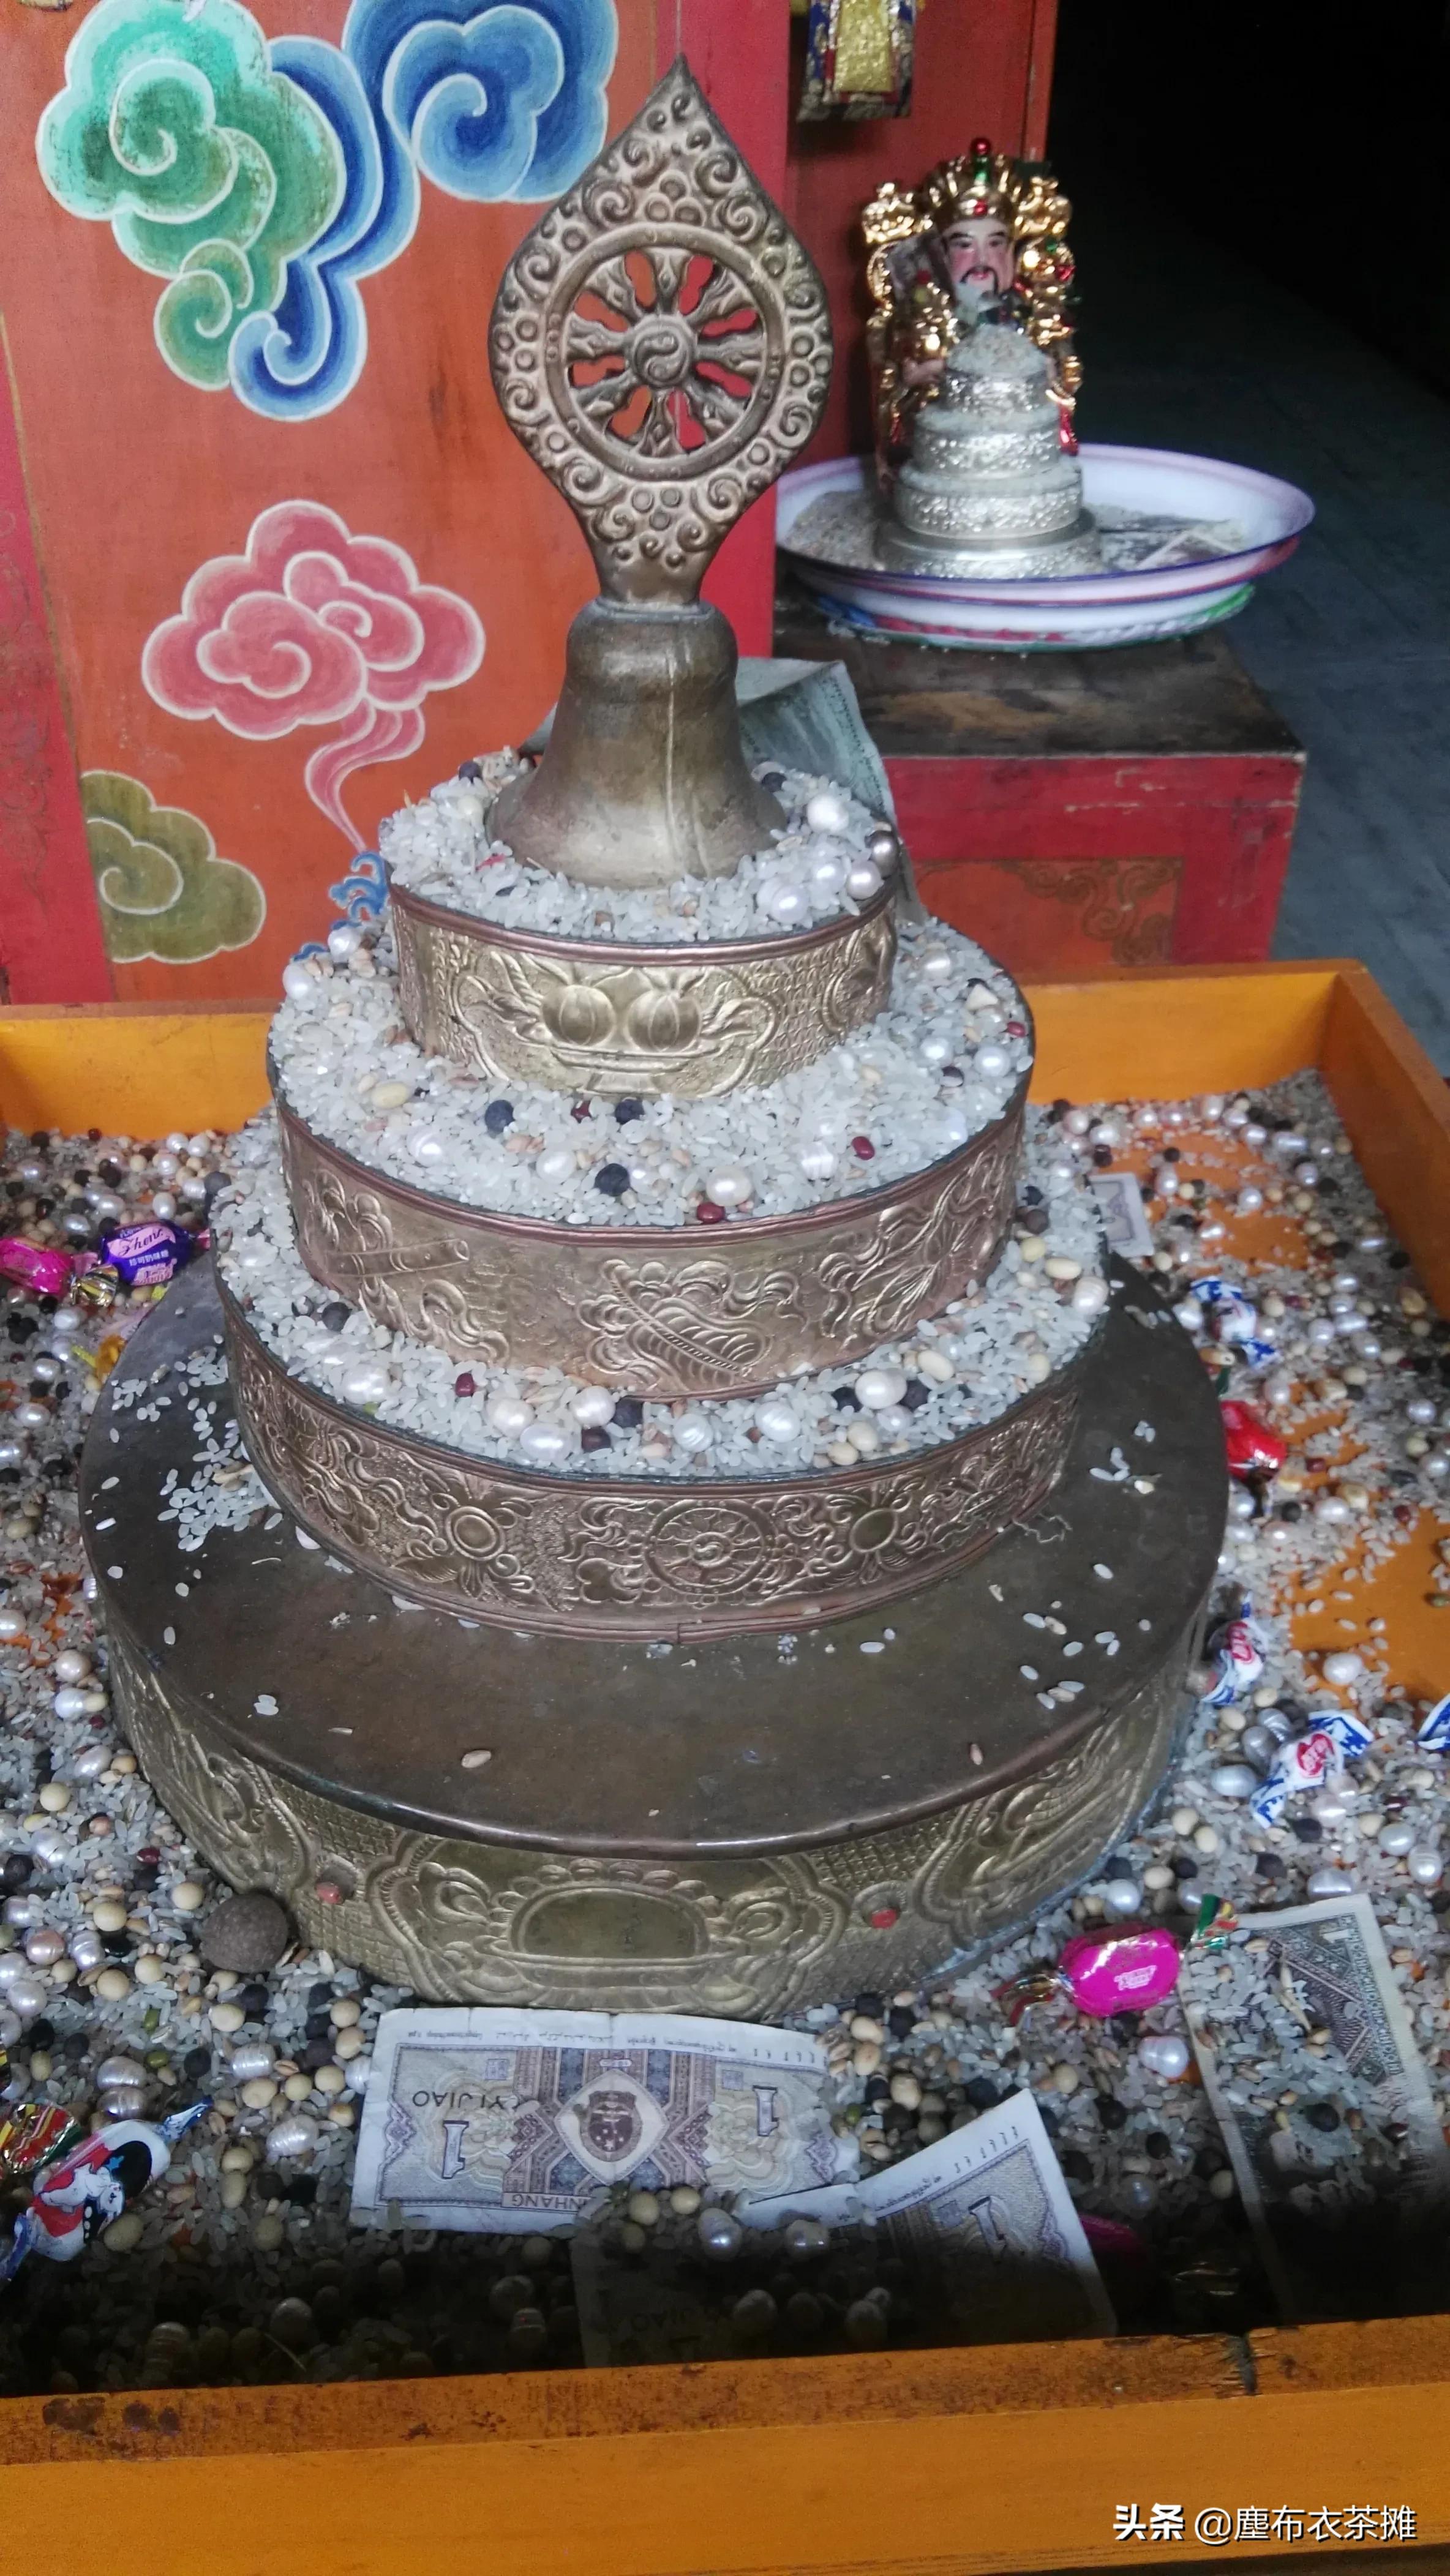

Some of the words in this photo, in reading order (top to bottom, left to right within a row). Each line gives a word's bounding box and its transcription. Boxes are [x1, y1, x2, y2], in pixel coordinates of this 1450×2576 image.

[412, 2090, 473, 2108] JIAO
[753, 2084, 779, 2136] 1
[441, 2120, 469, 2179] 1
[512, 2193, 585, 2211] NHANG
